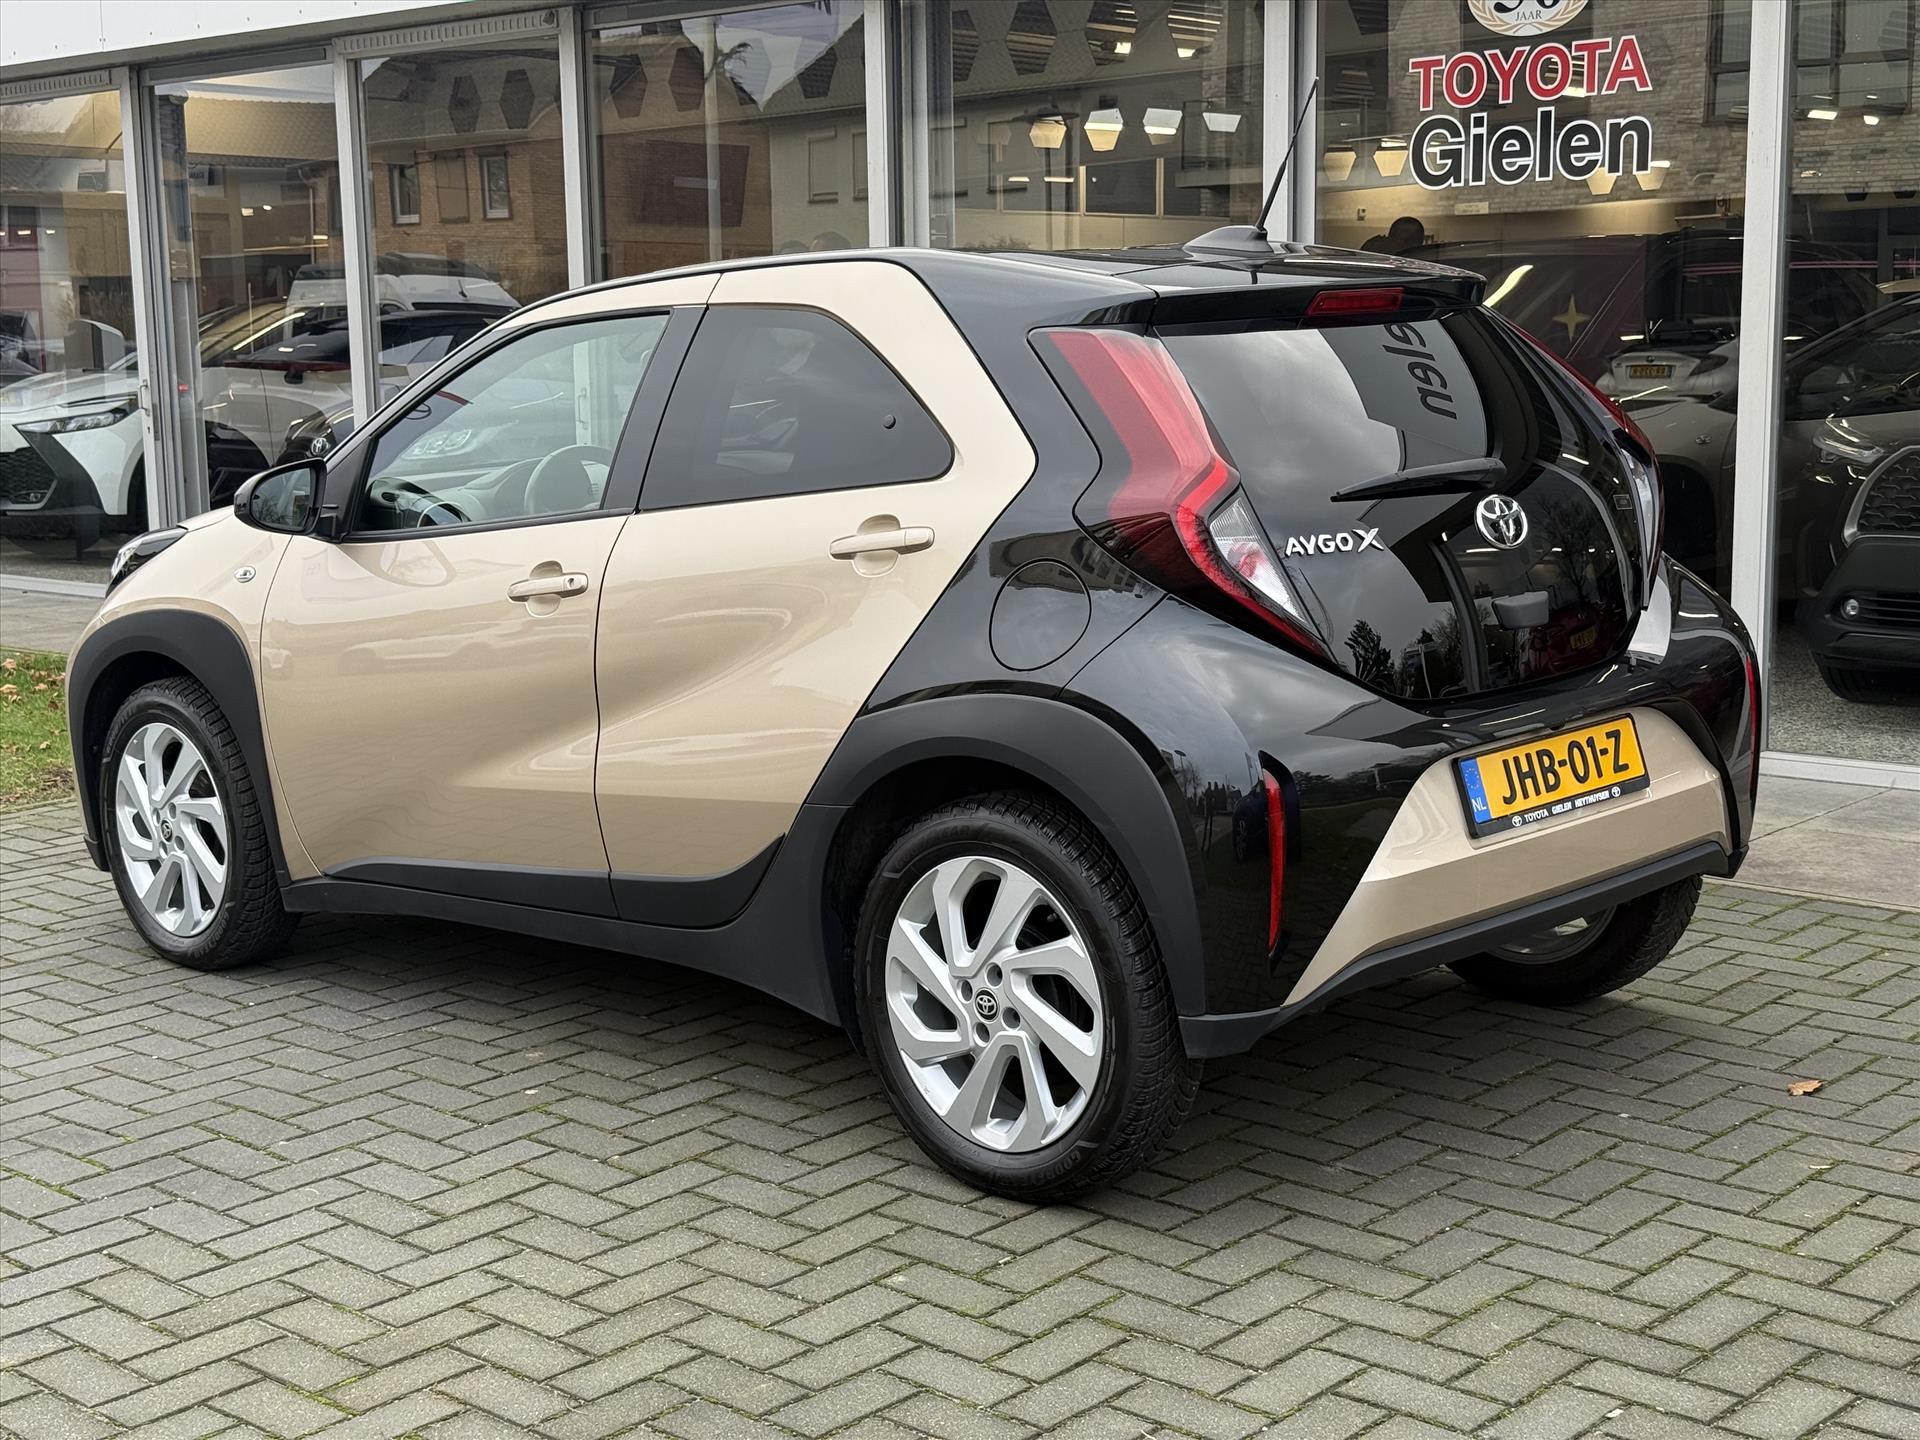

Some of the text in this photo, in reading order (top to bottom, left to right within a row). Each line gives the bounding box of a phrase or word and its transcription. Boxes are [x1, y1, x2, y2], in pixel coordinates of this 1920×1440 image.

[1514, 10, 1543, 21] JAAR
[1409, 35, 1653, 111] TOYOTA
[1409, 107, 1652, 190] Gielen
[1285, 527, 1385, 557] AYGO X
[1502, 728, 1629, 805] JHB-01-Z
[1472, 798, 1488, 812] NL
[1524, 808, 1549, 823] TOYOTA
[1552, 801, 1573, 815] GIELEN
